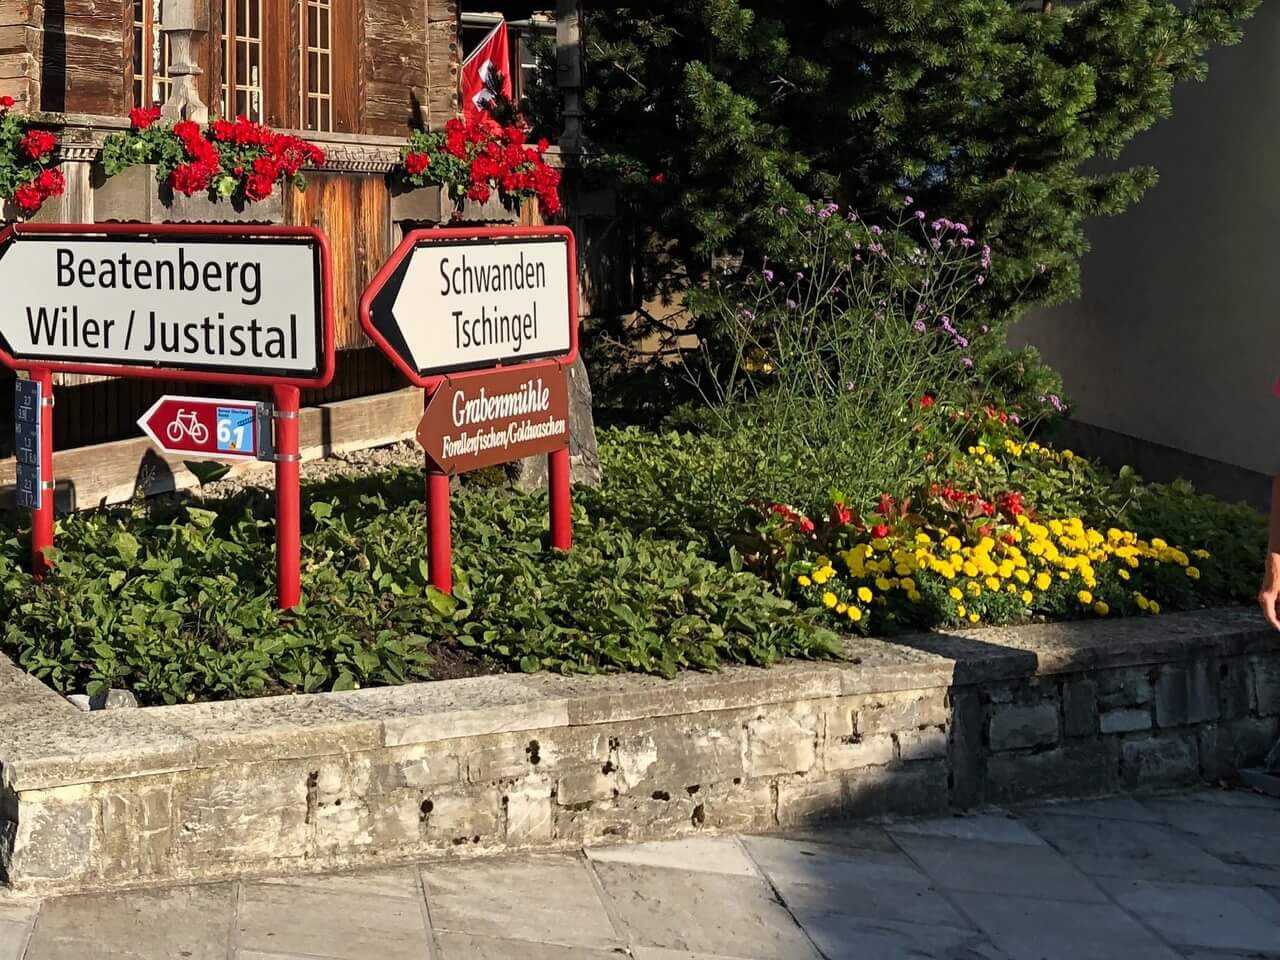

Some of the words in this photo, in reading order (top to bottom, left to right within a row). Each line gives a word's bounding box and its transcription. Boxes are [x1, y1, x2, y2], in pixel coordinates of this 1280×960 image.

[56, 247, 262, 305] Beatenberg
[439, 251, 546, 296] Schwanden
[25, 305, 115, 349] Wiler
[144, 311, 298, 359] Justistal
[451, 300, 538, 352] Tschingel
[452, 378, 550, 427] Grabenmühle
[216, 418, 245, 449] 61
[441, 415, 566, 459] Forellenfischen/Goldwaschen
